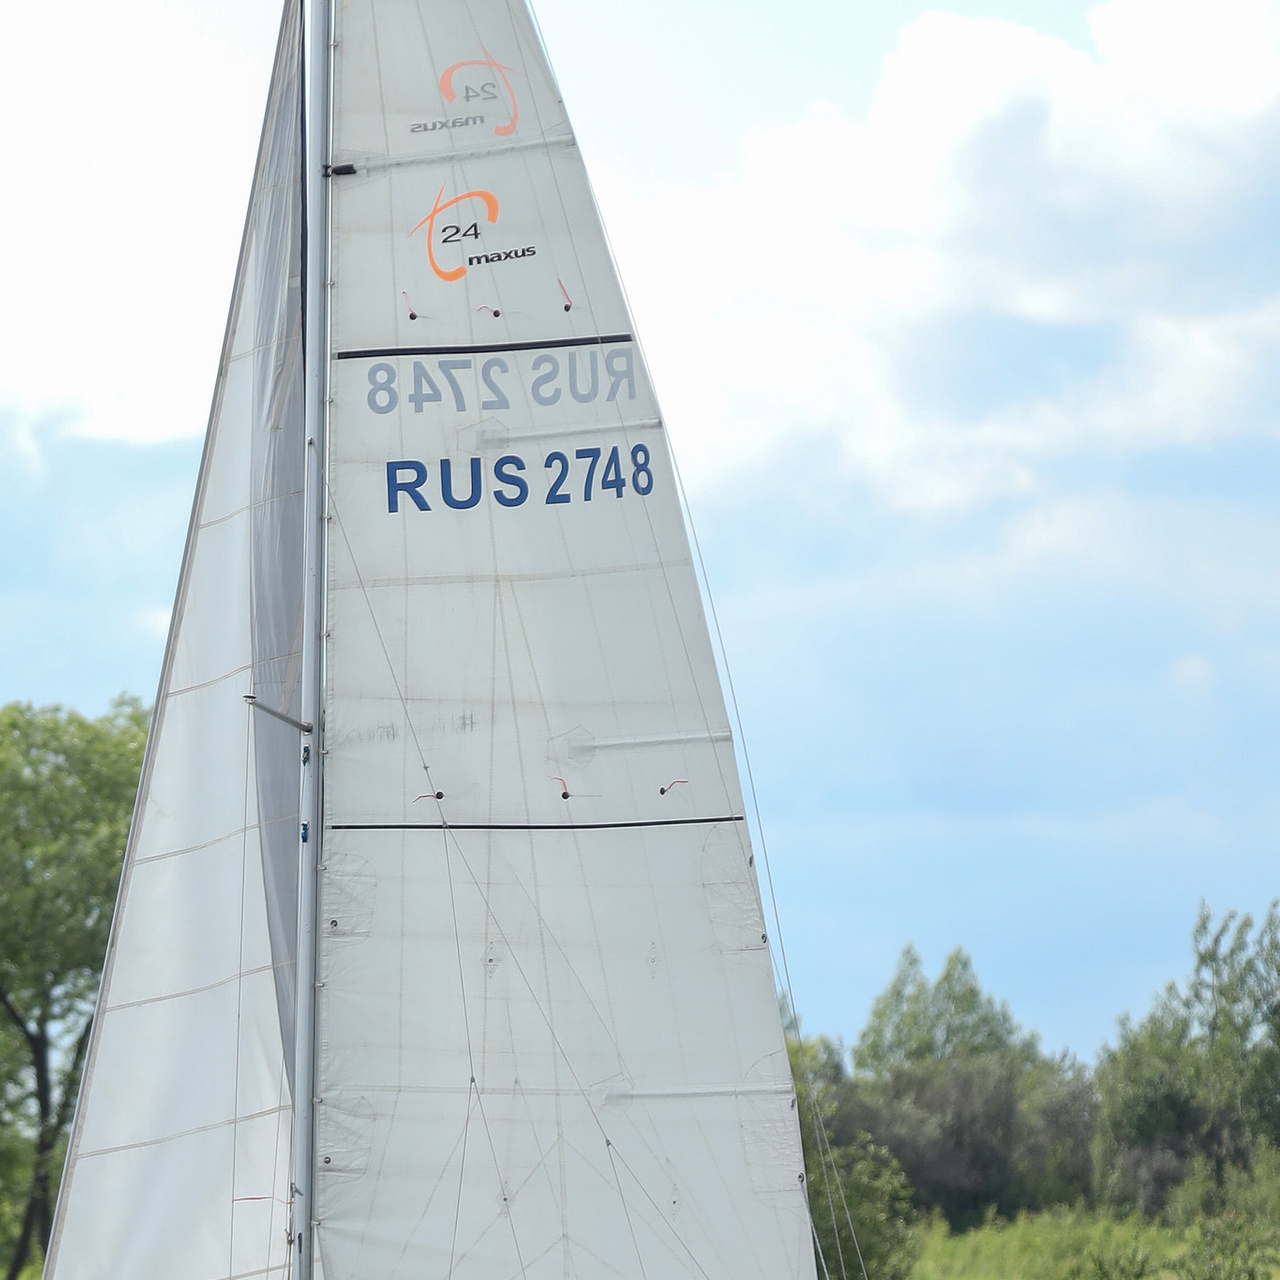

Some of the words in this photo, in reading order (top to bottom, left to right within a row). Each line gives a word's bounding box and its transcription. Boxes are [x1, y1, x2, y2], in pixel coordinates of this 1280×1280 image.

[441, 221, 481, 244] 24
[468, 245, 537, 266] maxus
[386, 455, 529, 514] RUS
[544, 443, 654, 505] 2748
